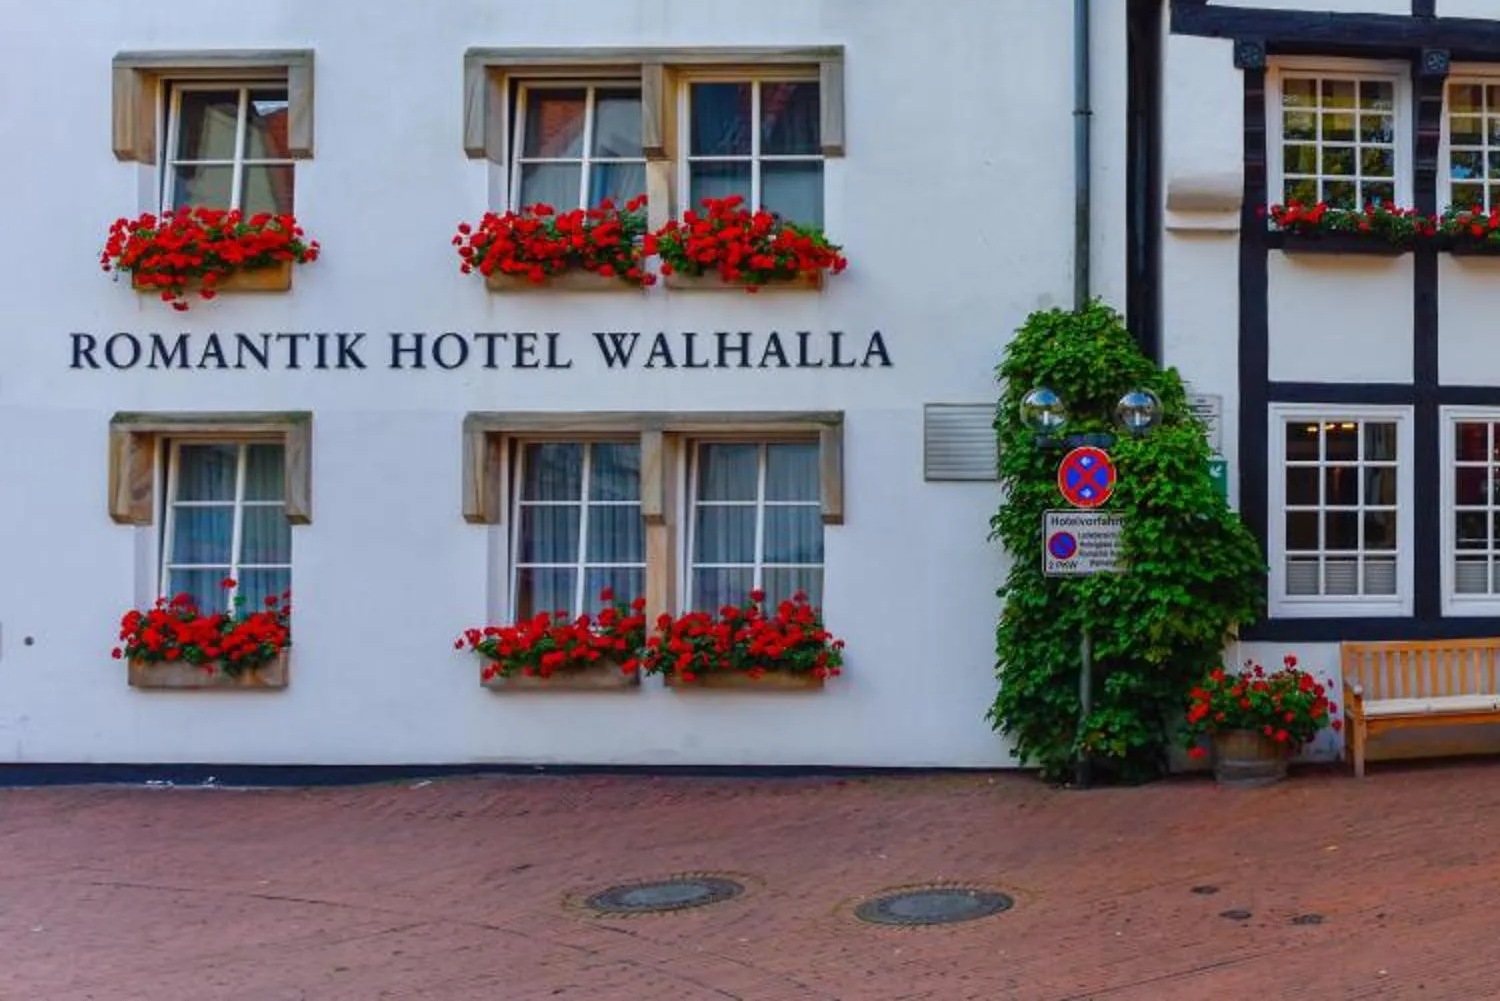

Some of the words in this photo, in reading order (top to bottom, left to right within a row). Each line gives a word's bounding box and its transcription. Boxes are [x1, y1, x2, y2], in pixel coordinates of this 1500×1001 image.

[69, 332, 368, 370] ROMANTIK
[388, 332, 573, 369] HOTEL
[592, 330, 894, 369] WALHALLA
